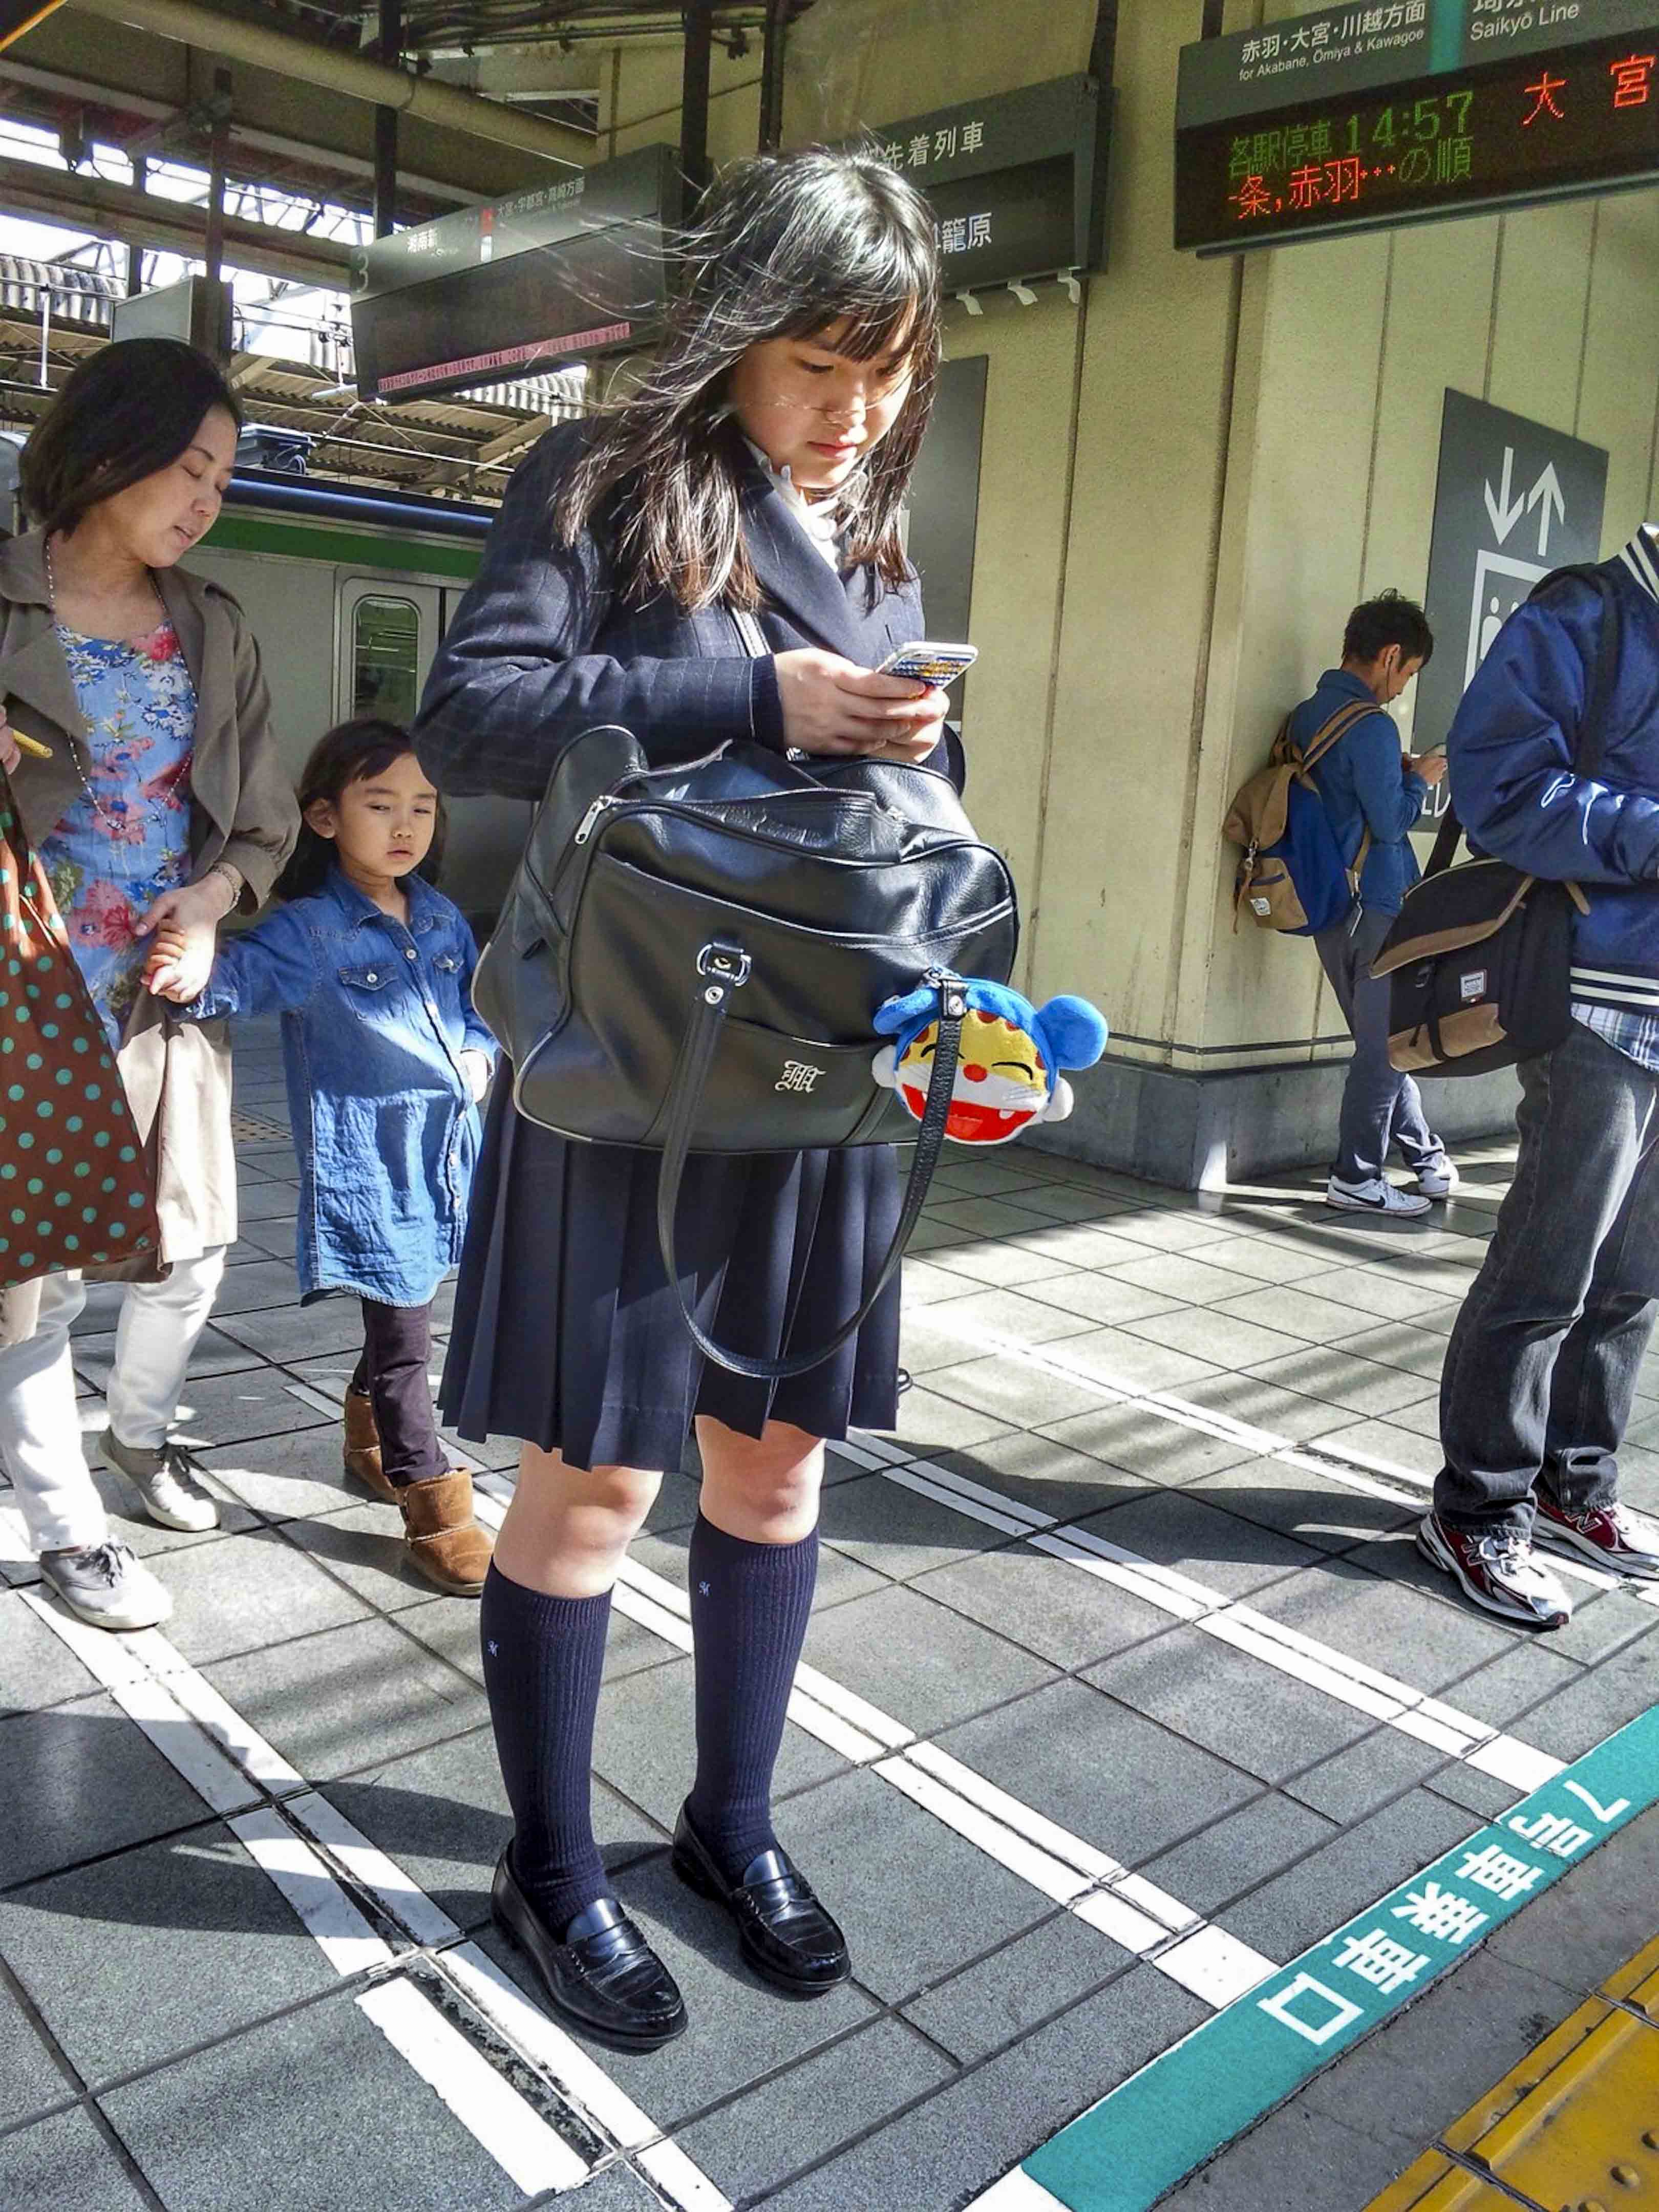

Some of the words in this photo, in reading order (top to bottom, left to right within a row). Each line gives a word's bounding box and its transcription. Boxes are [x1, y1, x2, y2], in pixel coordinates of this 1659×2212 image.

[1538, 4, 1580, 26] Line
[1239, 68, 1253, 81] for
[1257, 57, 1309, 77] Akabane,
[1354, 41, 1363, 53] &
[1366, 28, 1425, 51] Kawagoe
